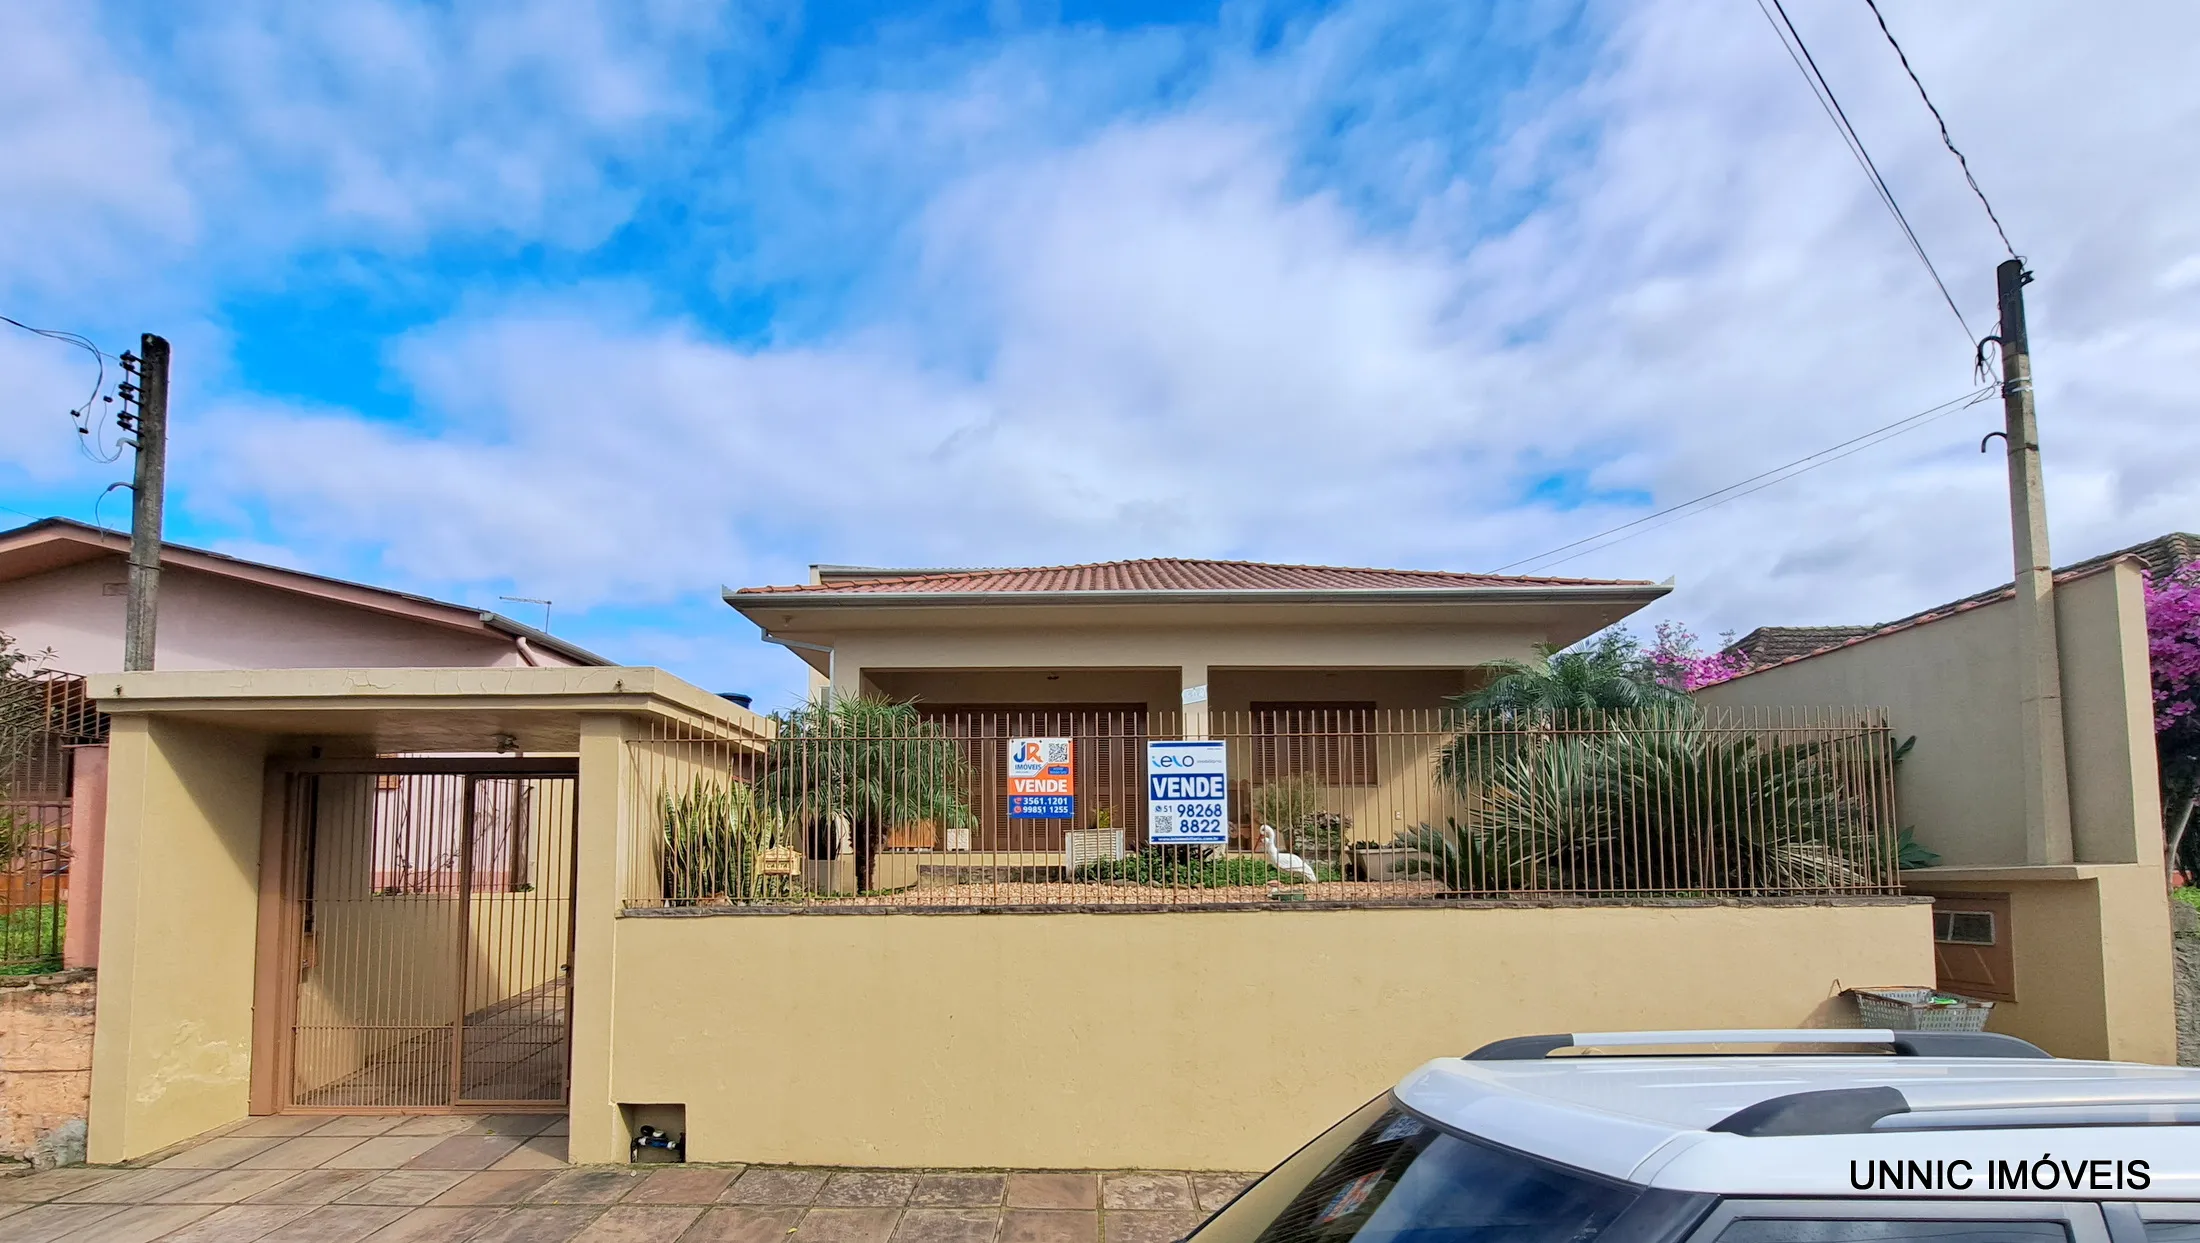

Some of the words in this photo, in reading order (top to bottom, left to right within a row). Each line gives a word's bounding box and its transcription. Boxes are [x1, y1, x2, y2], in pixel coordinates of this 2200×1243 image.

[1013, 742, 1043, 763] JR
[1015, 763, 1042, 771] IMÓVEIS
[1014, 779, 1068, 793] VENDE
[1152, 776, 1223, 798] VENDE
[1023, 797, 1068, 805] 3561.1201
[1023, 806, 1047, 814] 99851
[1050, 806, 1069, 814] 1255
[1163, 805, 1173, 813] 51
[1177, 803, 1223, 818] 98268
[1180, 819, 1221, 833] 8822
